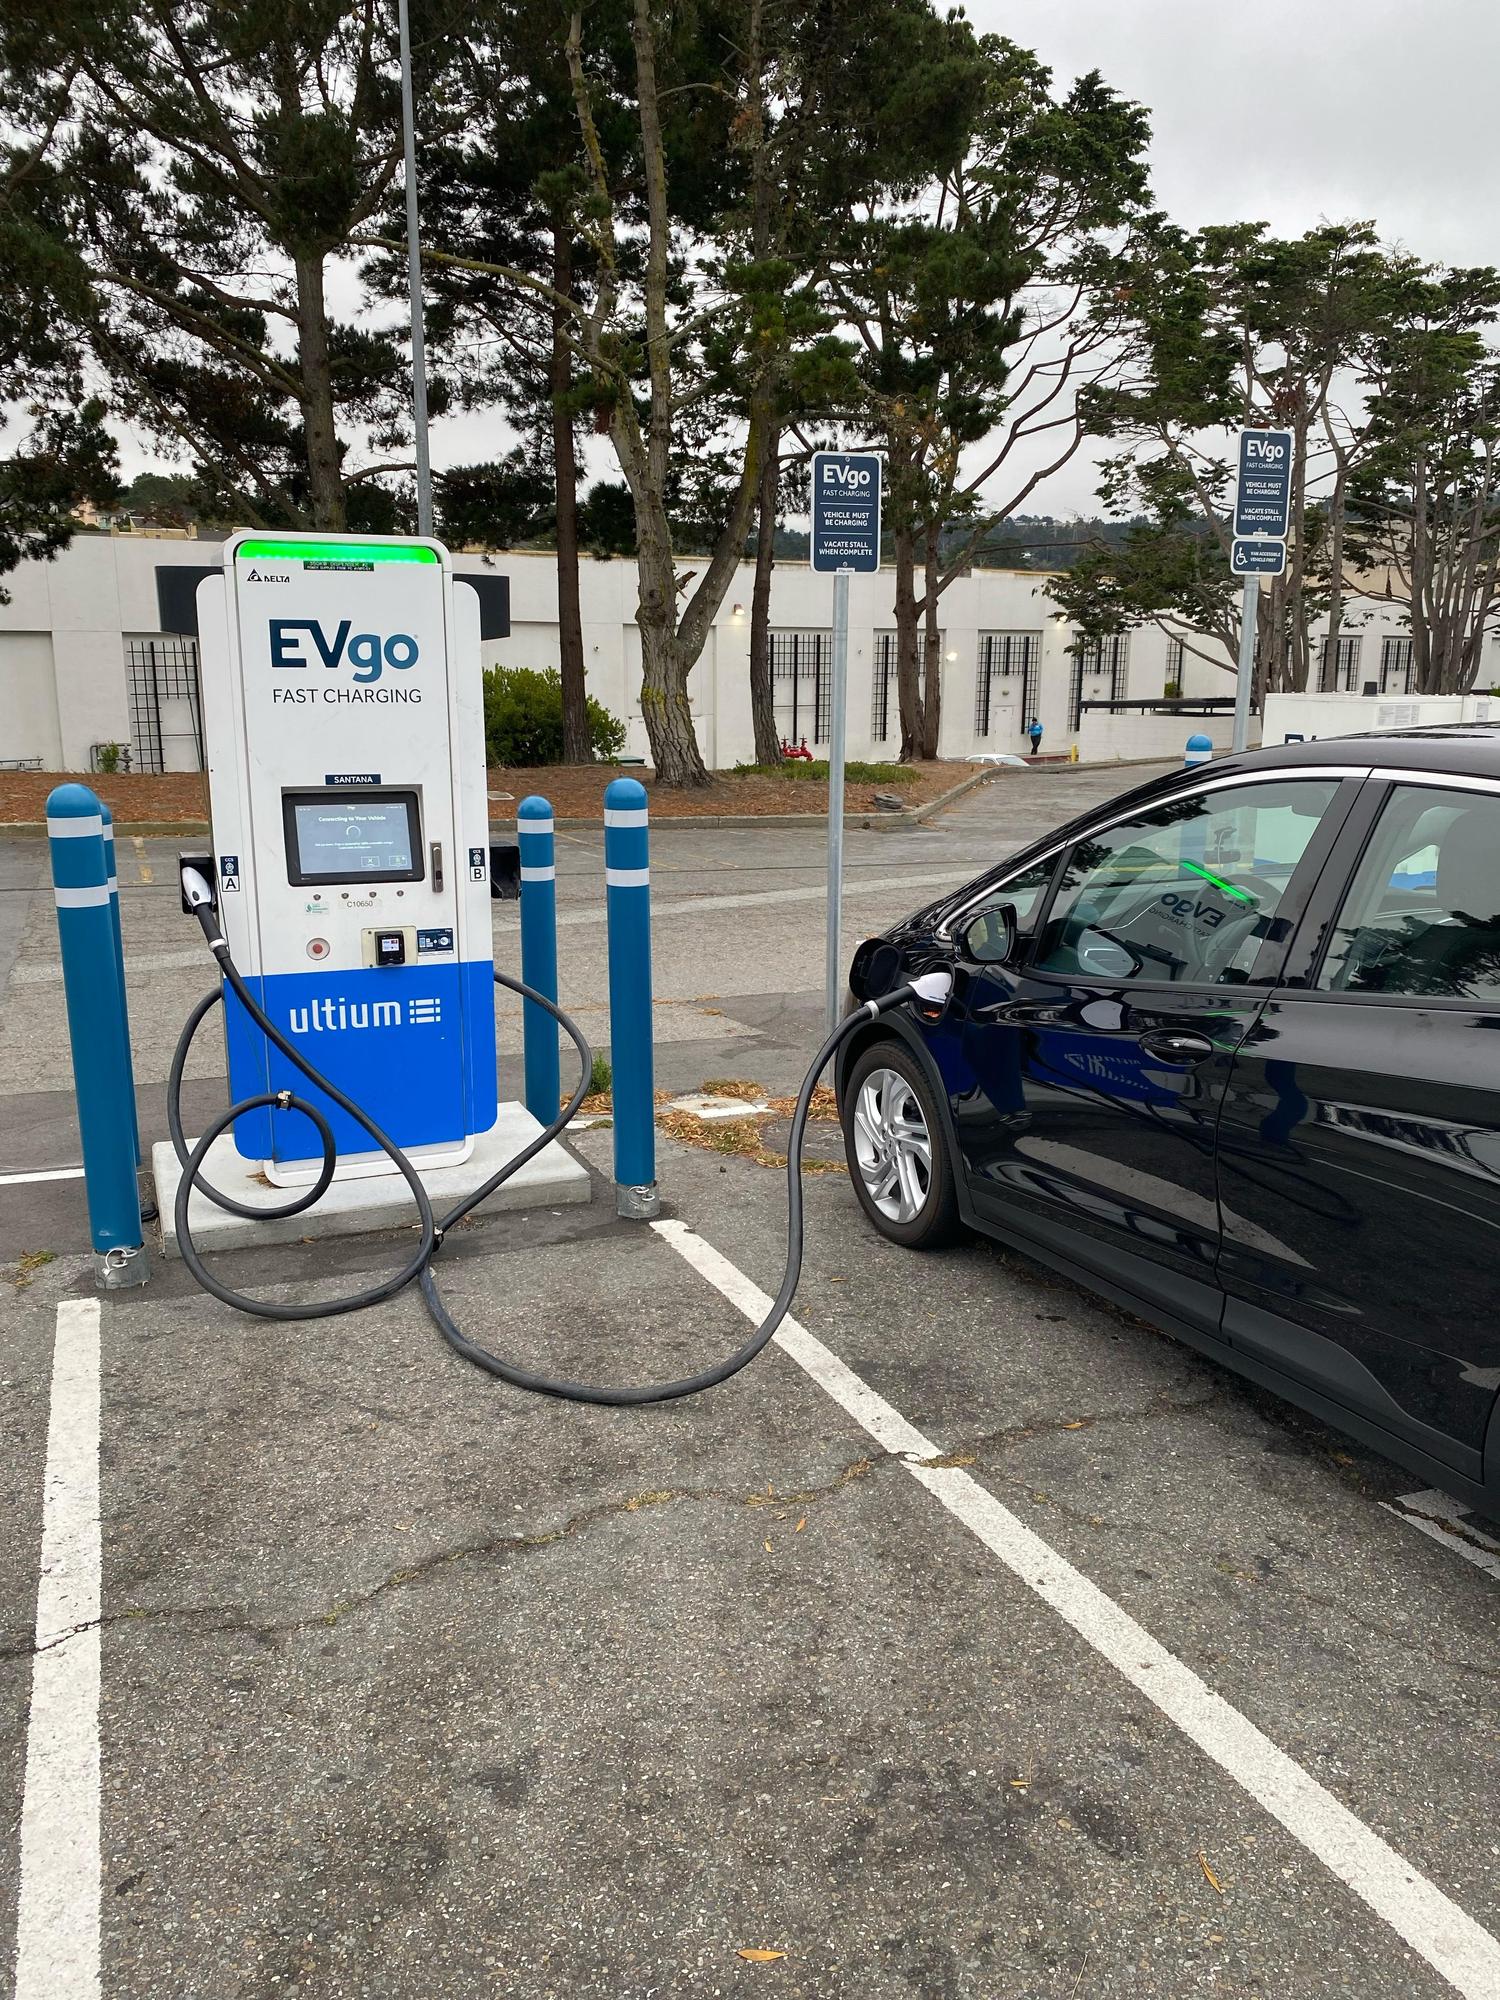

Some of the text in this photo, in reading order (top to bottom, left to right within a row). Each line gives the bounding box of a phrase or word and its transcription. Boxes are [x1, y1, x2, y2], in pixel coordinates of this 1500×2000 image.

[1246, 440, 1284, 462] EVgo
[823, 464, 870, 490] EVgo
[264, 575, 290, 583] DELTA
[269, 619, 419, 684] EVgo
[273, 689, 422, 704] FAST CHARGING
[474, 868, 482, 879] B
[225, 878, 236, 889] A
[290, 998, 402, 1033] ultium
